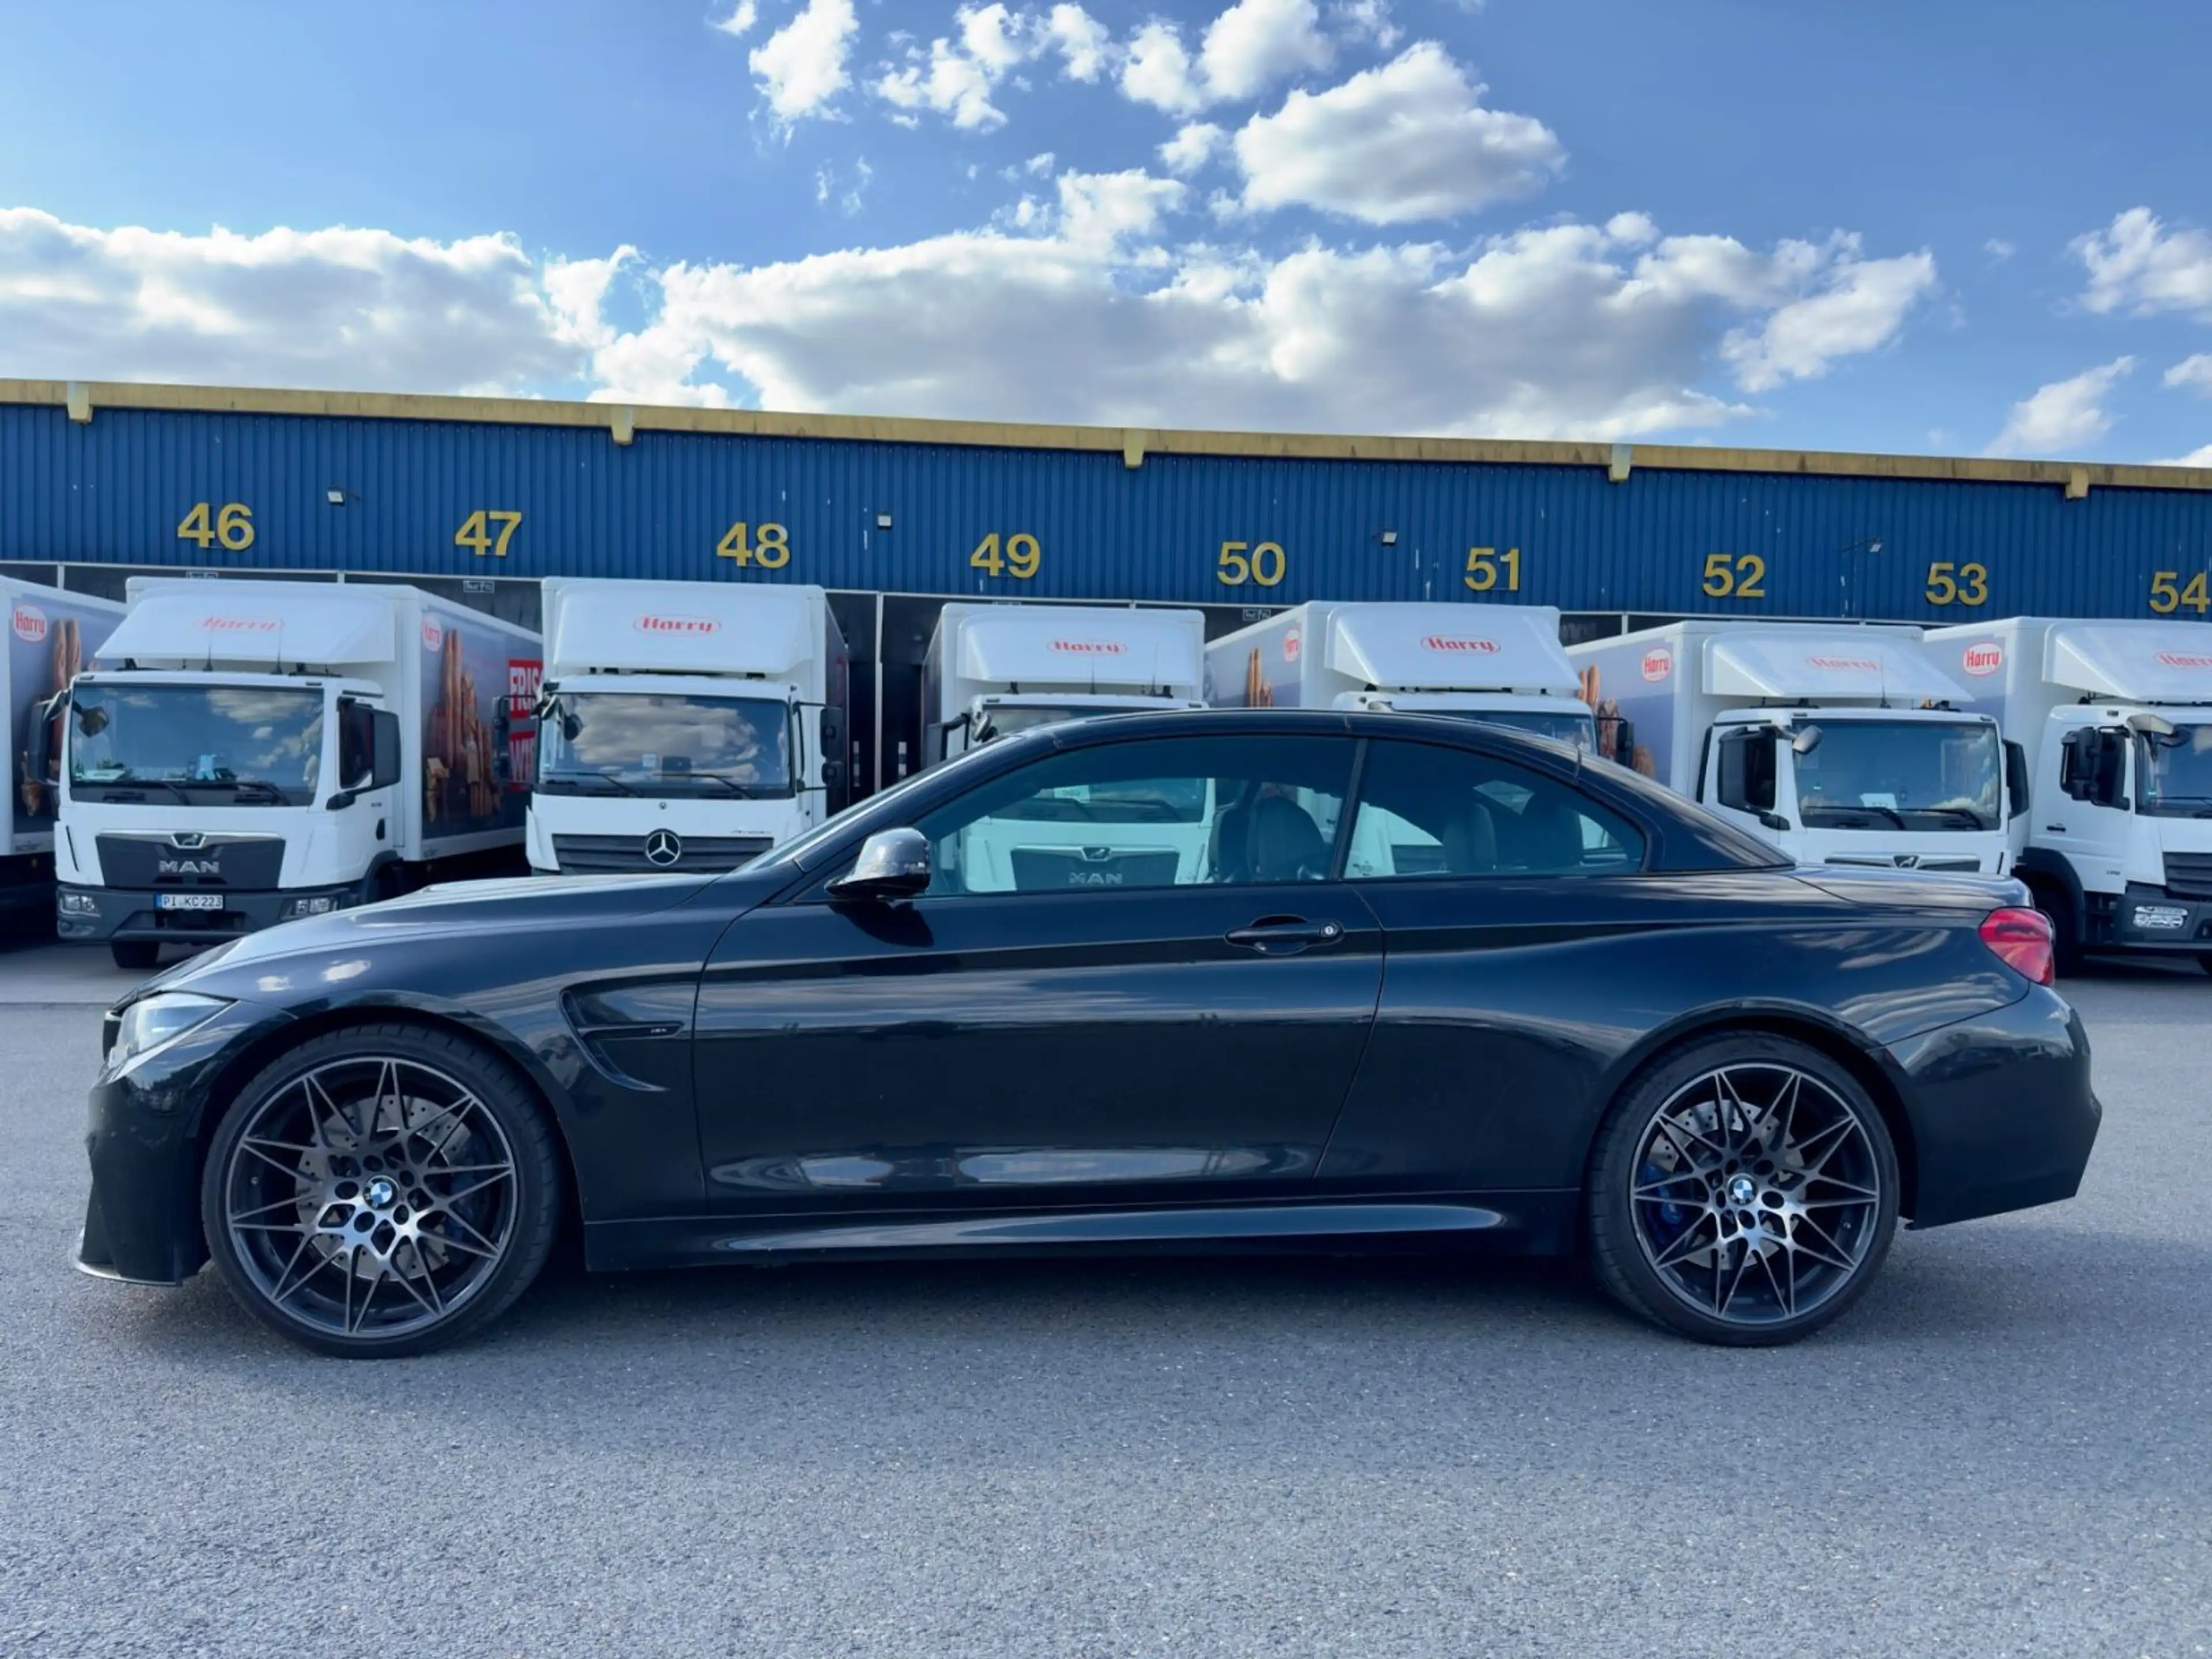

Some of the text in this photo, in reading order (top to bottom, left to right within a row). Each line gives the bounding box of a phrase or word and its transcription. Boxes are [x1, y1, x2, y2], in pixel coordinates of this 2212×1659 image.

[177, 502, 254, 550] 46
[454, 510, 522, 556] 47
[717, 522, 790, 569] 48
[970, 533, 1040, 578] 49
[1218, 541, 1286, 586] 50
[1464, 547, 1520, 591] 51
[1703, 554, 1765, 597] 52
[1926, 563, 1988, 605] 53
[2149, 571, 2211, 613] 54
[642, 617, 713, 632] Harry
[1427, 638, 1494, 652] Harry
[1054, 641, 1120, 653] Harry
[1965, 650, 1999, 668] Harry
[2159, 654, 2212, 666] Harr
[159, 860, 220, 873] MAN
[1069, 872, 1123, 885] MAN
[184, 897, 199, 907] KC
[202, 897, 222, 907] 223
